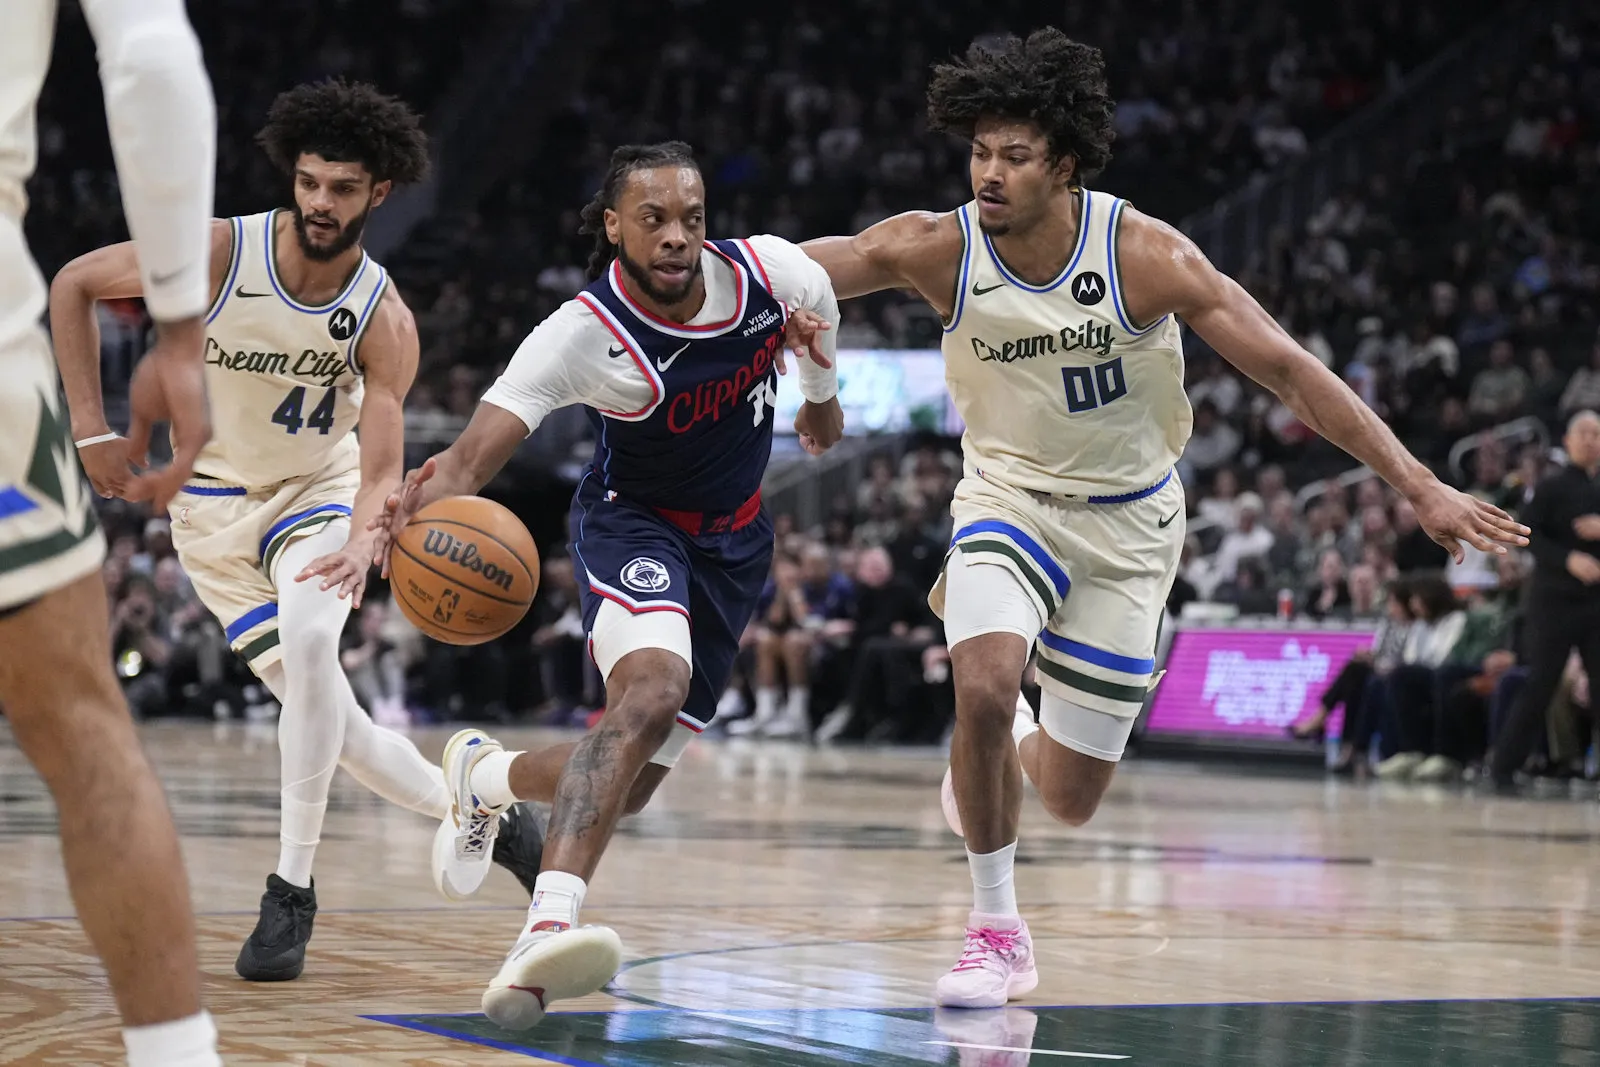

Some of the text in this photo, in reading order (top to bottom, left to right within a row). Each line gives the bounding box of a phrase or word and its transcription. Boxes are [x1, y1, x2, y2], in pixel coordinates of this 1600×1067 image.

[743, 312, 780, 337] RWANDA
[748, 309, 770, 326] VISIT
[971, 319, 1115, 363] Cream City
[205, 337, 347, 387] Cream City
[667, 326, 785, 433] Clipper
[1061, 357, 1127, 413] 00
[271, 386, 336, 435] 44
[424, 528, 514, 592] Wilson
